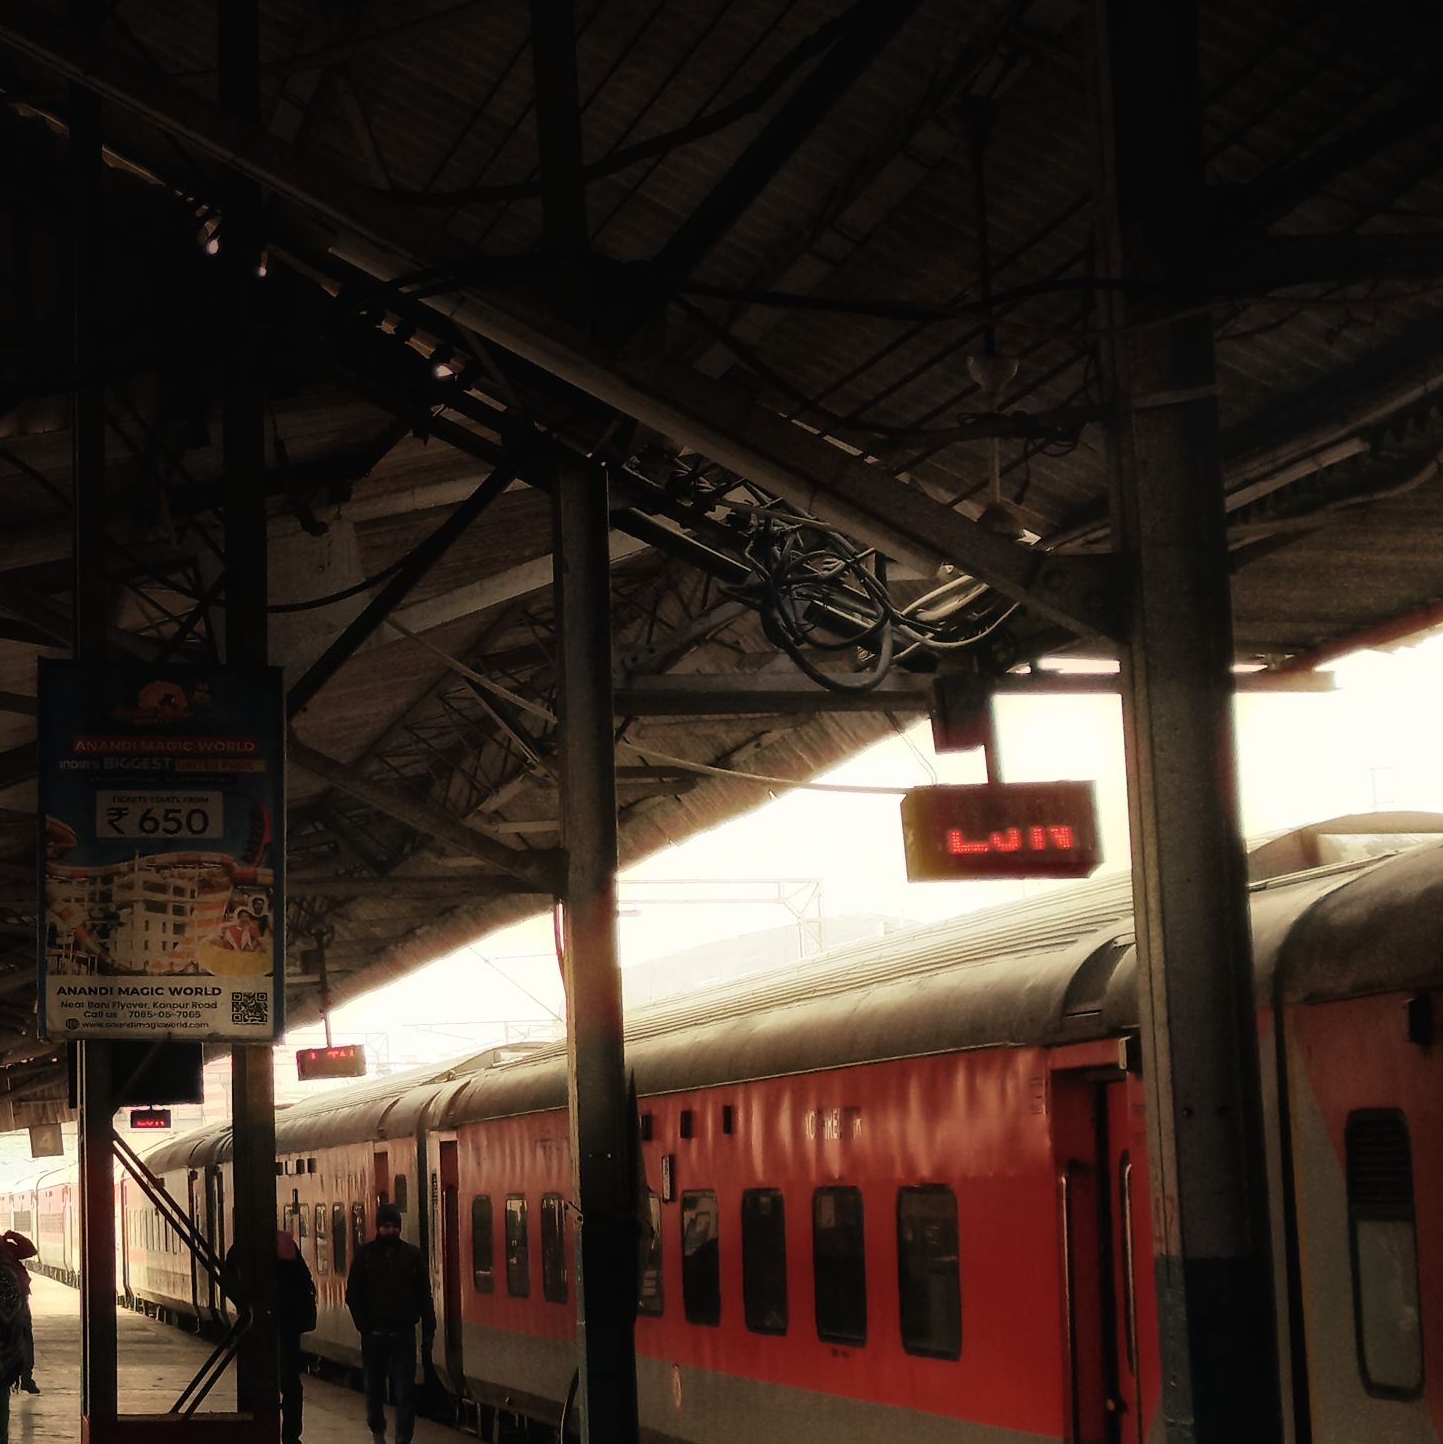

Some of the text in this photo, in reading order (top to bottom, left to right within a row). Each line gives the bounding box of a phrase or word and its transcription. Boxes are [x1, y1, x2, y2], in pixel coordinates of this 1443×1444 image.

[74, 739, 256, 753] ANANDI MAGIC WORLD
[103, 757, 173, 771] BIGGEST
[112, 795, 147, 803] TICKETS
[182, 796, 209, 804] FROM
[138, 808, 209, 835] 650
[56, 986, 222, 996] ANANDI MAGIC WORLD
[60, 1001, 85, 1009] Near
[152, 1001, 189, 1010] Kanpur
[191, 1001, 218, 1009] Road
[83, 1010, 104, 1018] Call
